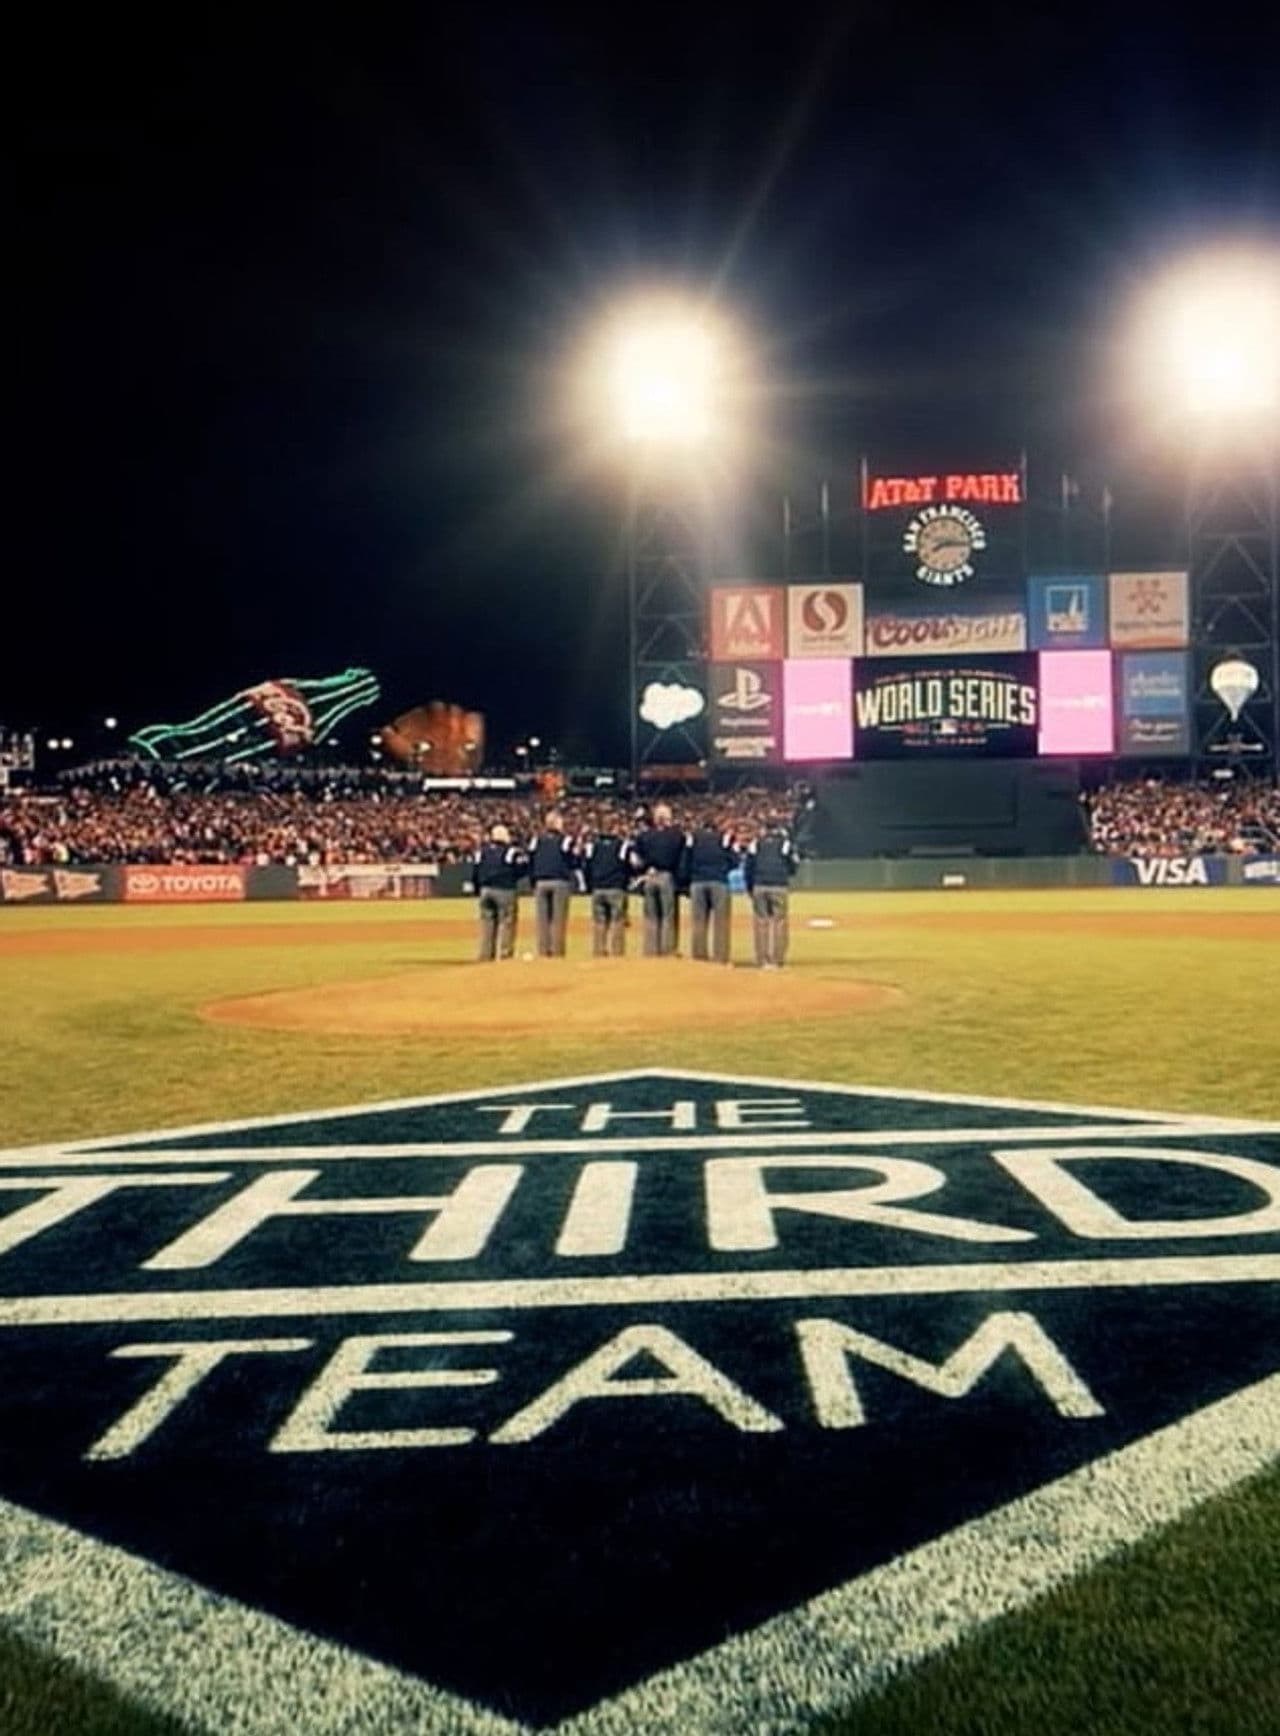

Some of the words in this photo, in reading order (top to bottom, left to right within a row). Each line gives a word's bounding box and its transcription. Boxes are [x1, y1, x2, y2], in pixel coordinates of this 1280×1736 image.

[870, 478, 938, 509] AT&T
[945, 474, 1020, 503] PARK
[918, 503, 987, 550] FRANCISCO
[916, 564, 974, 585] GIANTS
[855, 679, 942, 729] WORLD
[949, 678, 1037, 727] SERIES
[161, 874, 242, 892] TOYOTA
[1130, 857, 1209, 884] VISA
[476, 1097, 812, 1134] THE
[0, 1147, 1280, 1270] THIRD
[82, 1310, 1107, 1464] TEAM
